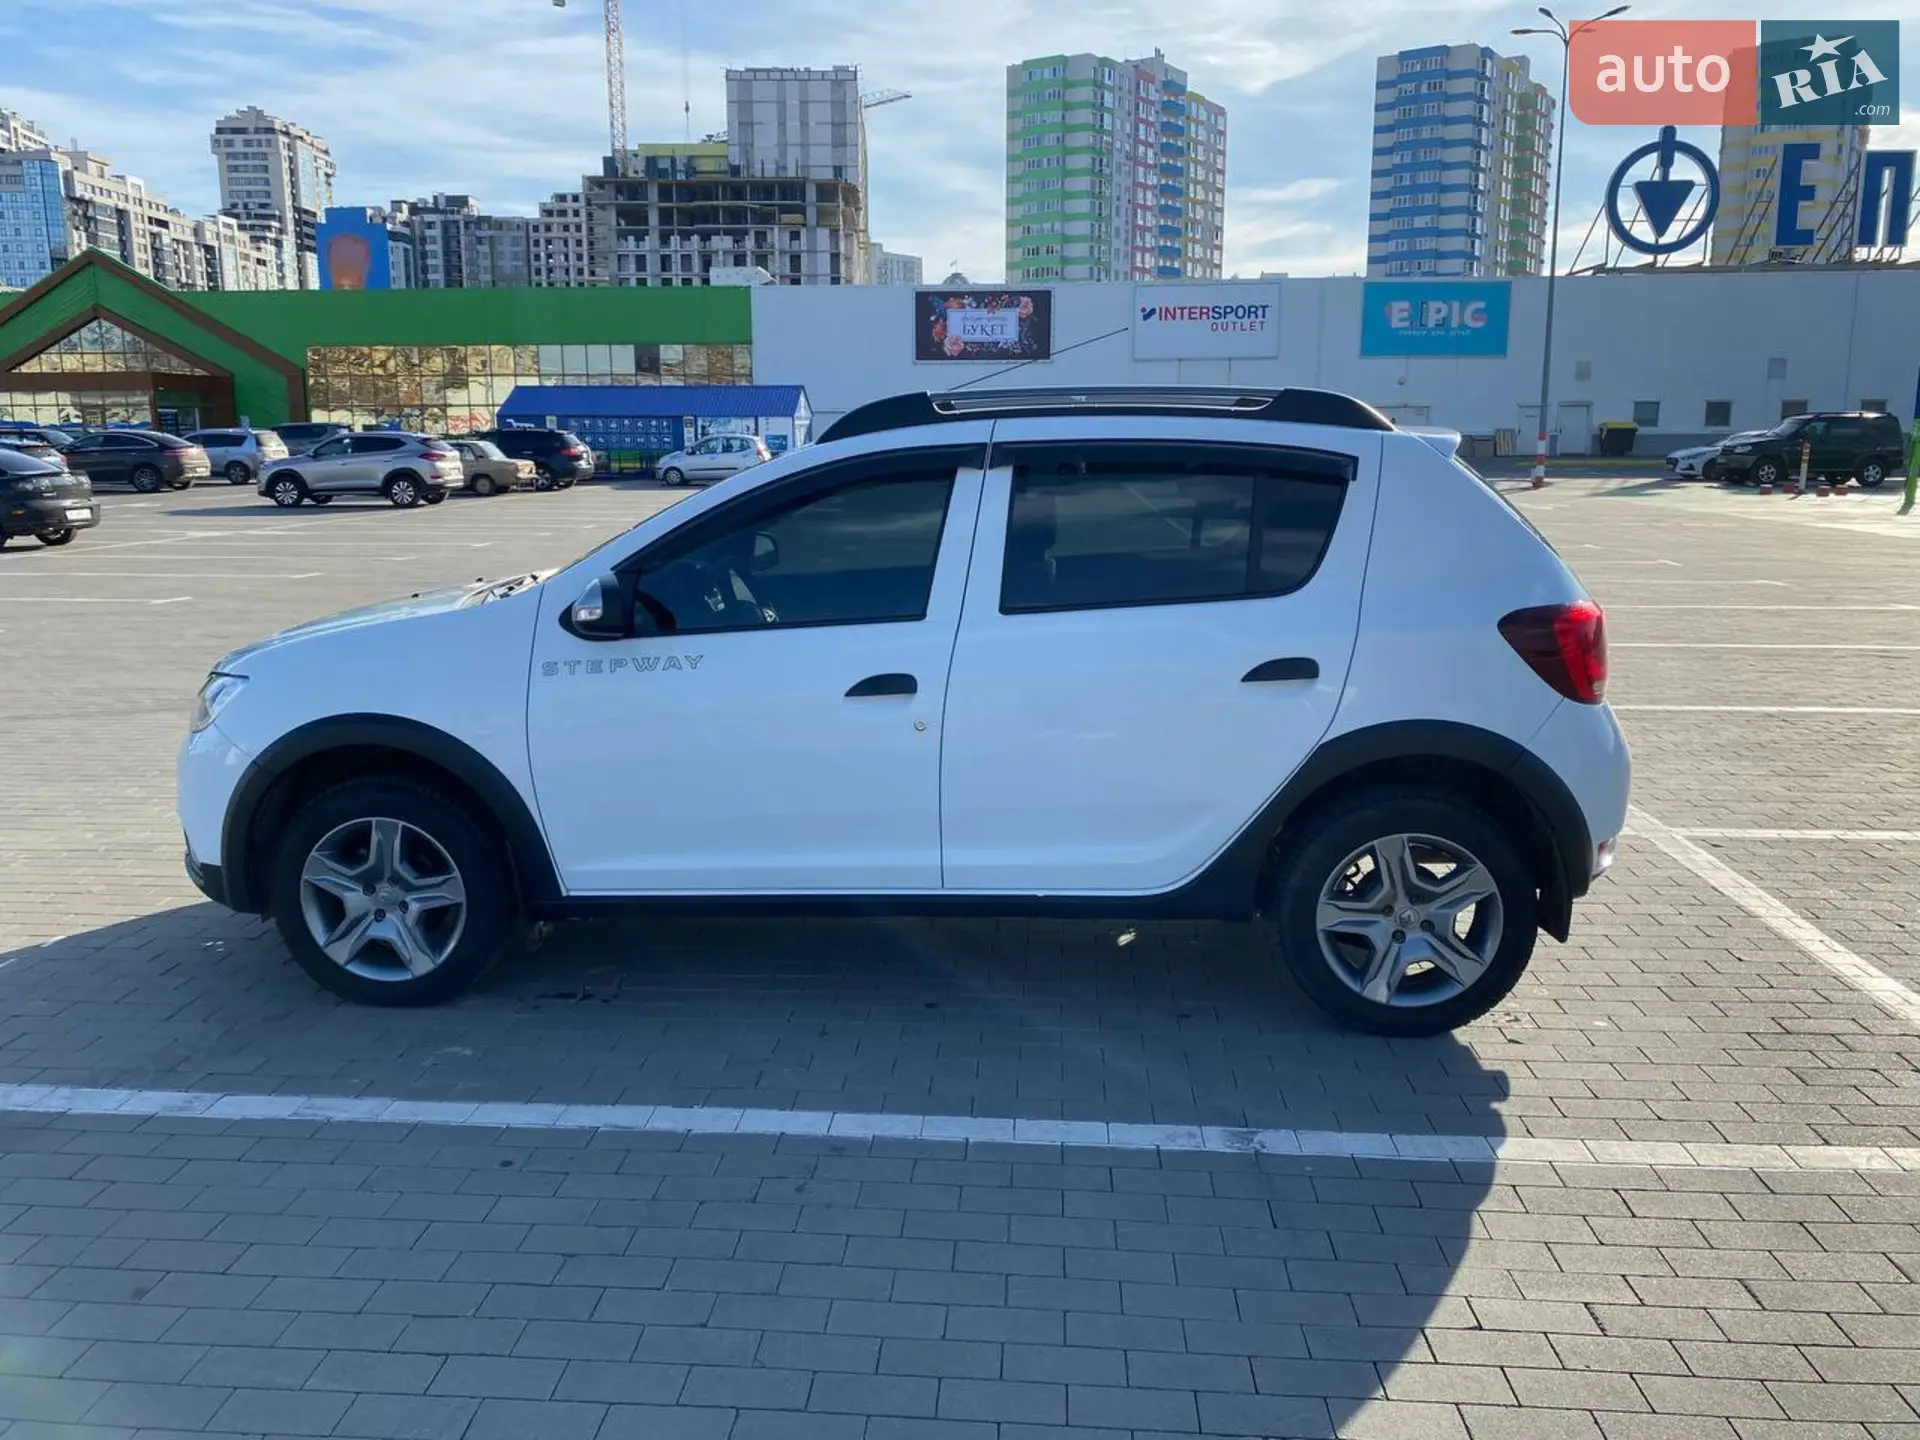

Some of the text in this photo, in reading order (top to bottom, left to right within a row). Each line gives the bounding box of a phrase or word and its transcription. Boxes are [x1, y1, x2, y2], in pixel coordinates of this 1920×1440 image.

[1158, 304, 1269, 321] INTERSPORT
[962, 323, 1008, 337] БУКЕТ
[1211, 320, 1266, 333] OUTLET
[541, 654, 704, 677] STEPWAY
